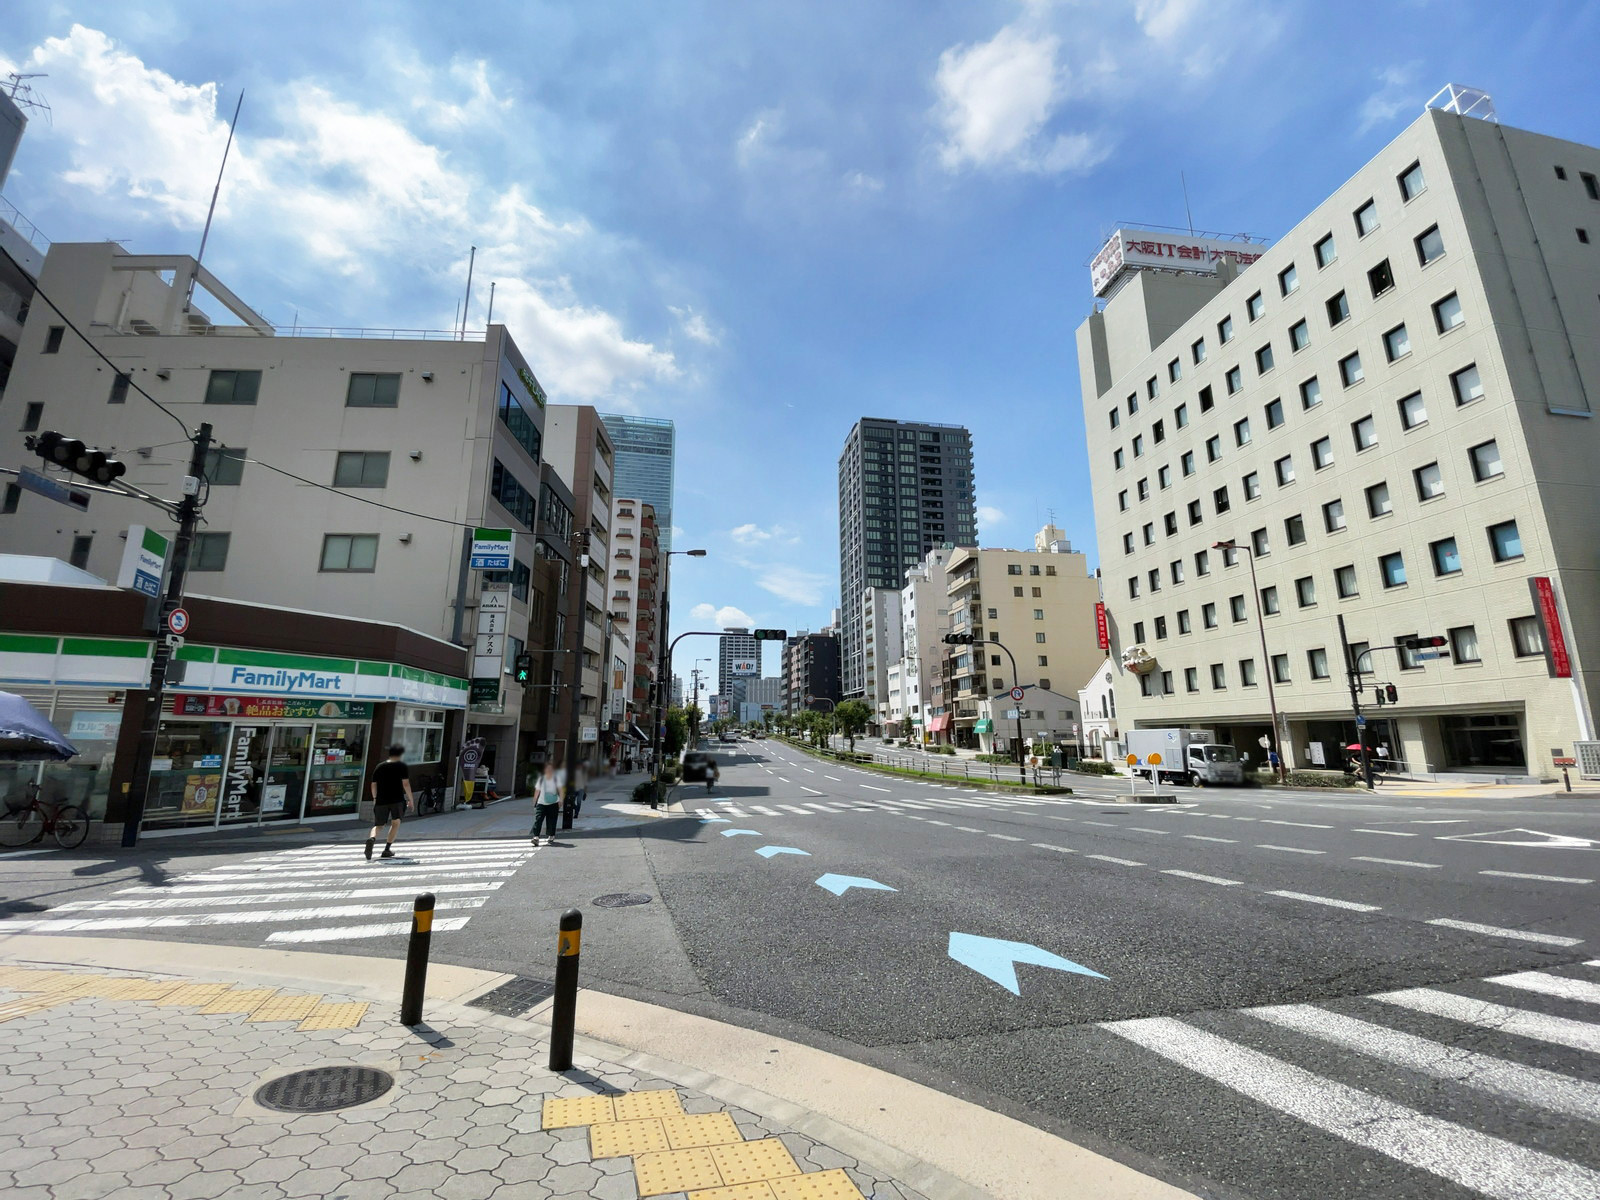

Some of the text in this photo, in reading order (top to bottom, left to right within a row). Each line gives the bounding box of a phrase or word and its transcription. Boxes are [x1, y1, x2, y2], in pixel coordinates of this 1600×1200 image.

[1126, 239, 1207, 261] 大阪IT会計
[474, 543, 509, 551] FamilyMart
[140, 554, 161, 570] FamilyMart
[475, 558, 506, 567] 酒 たばこ
[231, 667, 341, 691] FamilyMart
[246, 704, 318, 717] 絶品おむすび
[226, 727, 257, 818] FamilyMart
